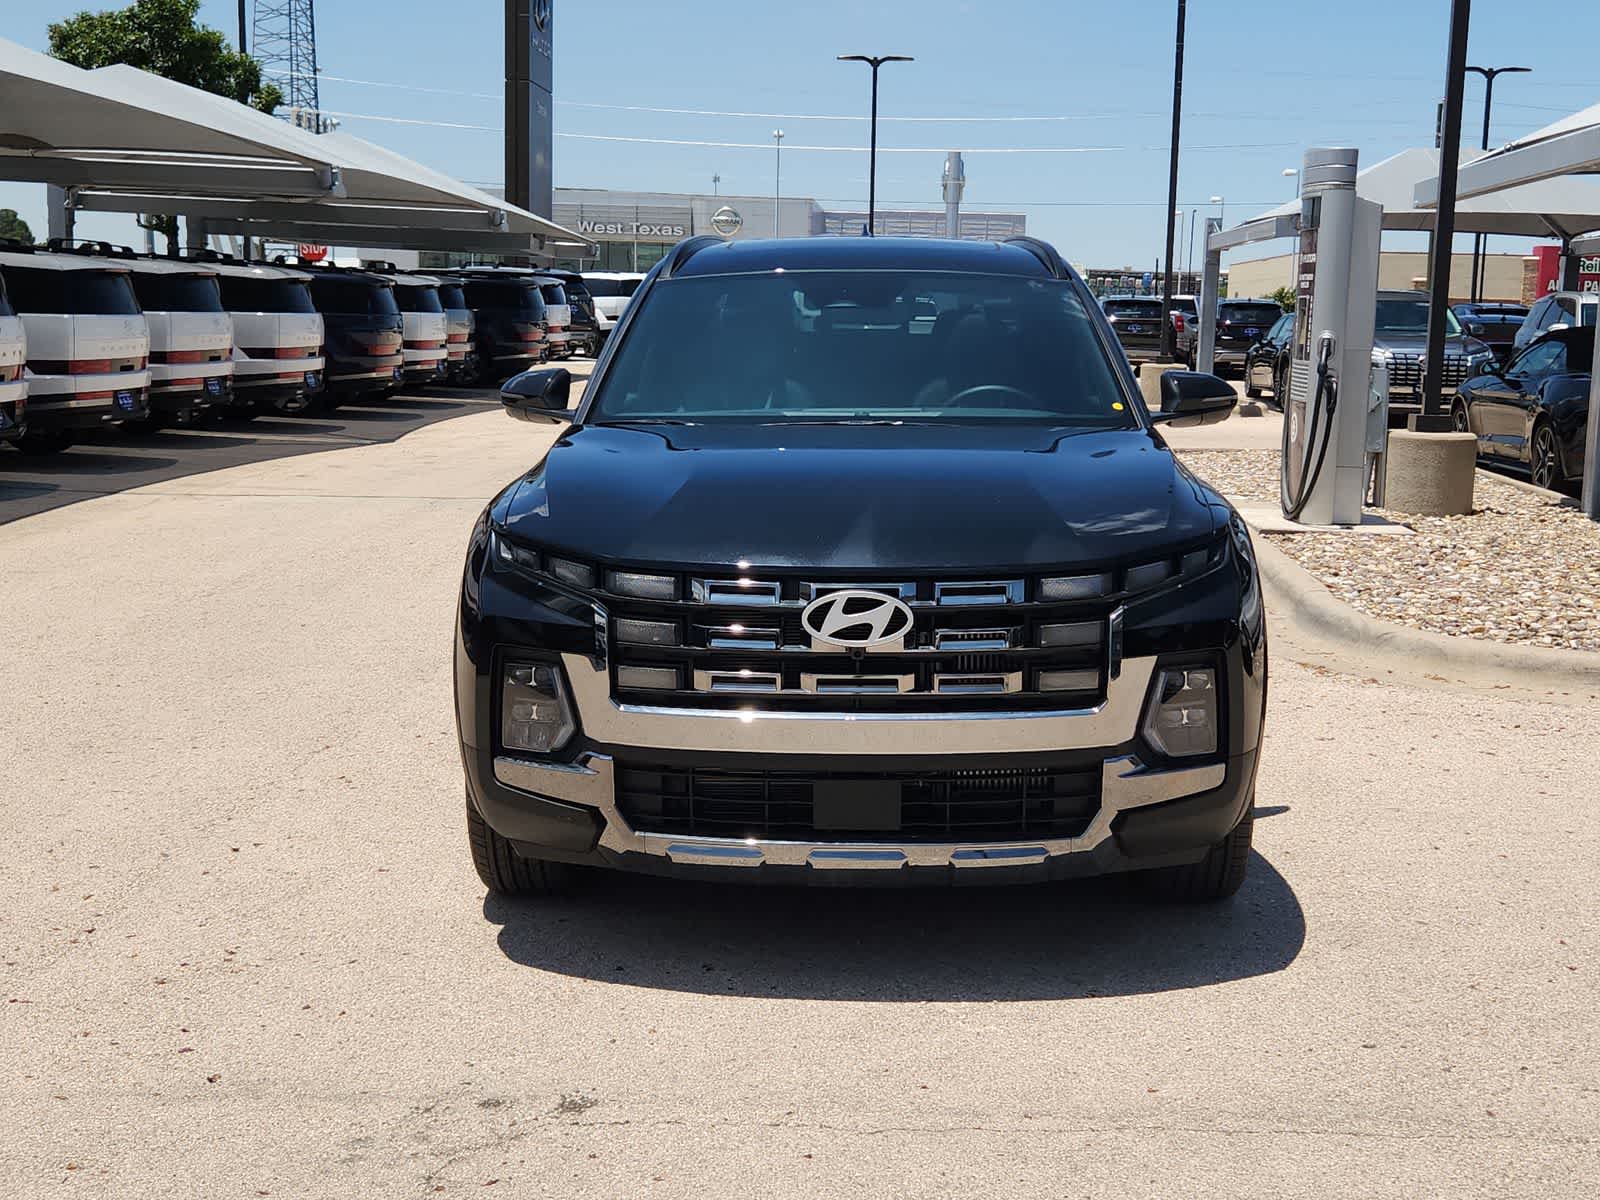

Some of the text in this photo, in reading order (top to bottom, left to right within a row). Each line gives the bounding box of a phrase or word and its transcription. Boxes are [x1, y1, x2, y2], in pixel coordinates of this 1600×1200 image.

[577, 221, 684, 236] West Texas
[302, 243, 326, 254] STOP
